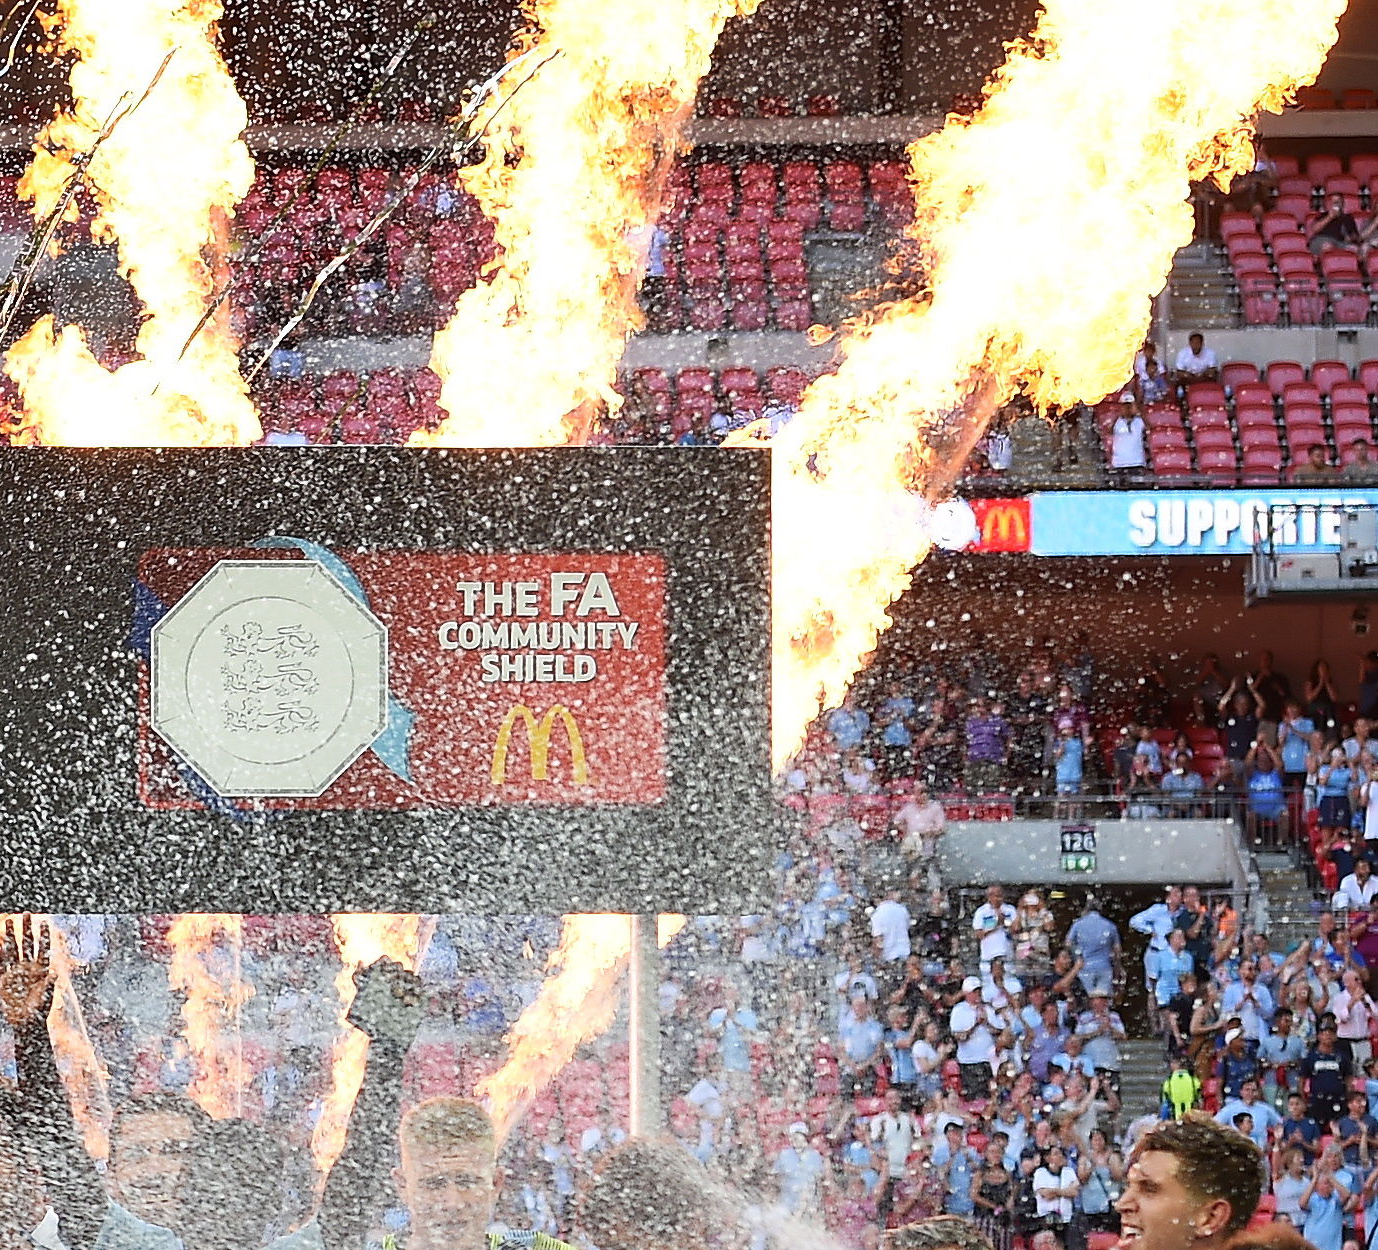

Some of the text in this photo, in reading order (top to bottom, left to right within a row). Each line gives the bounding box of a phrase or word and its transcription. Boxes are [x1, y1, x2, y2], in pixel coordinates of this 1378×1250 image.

[458, 572, 621, 617] THE FA
[438, 621, 639, 651] COMMUNITY
[481, 654, 597, 683] SHIELD
